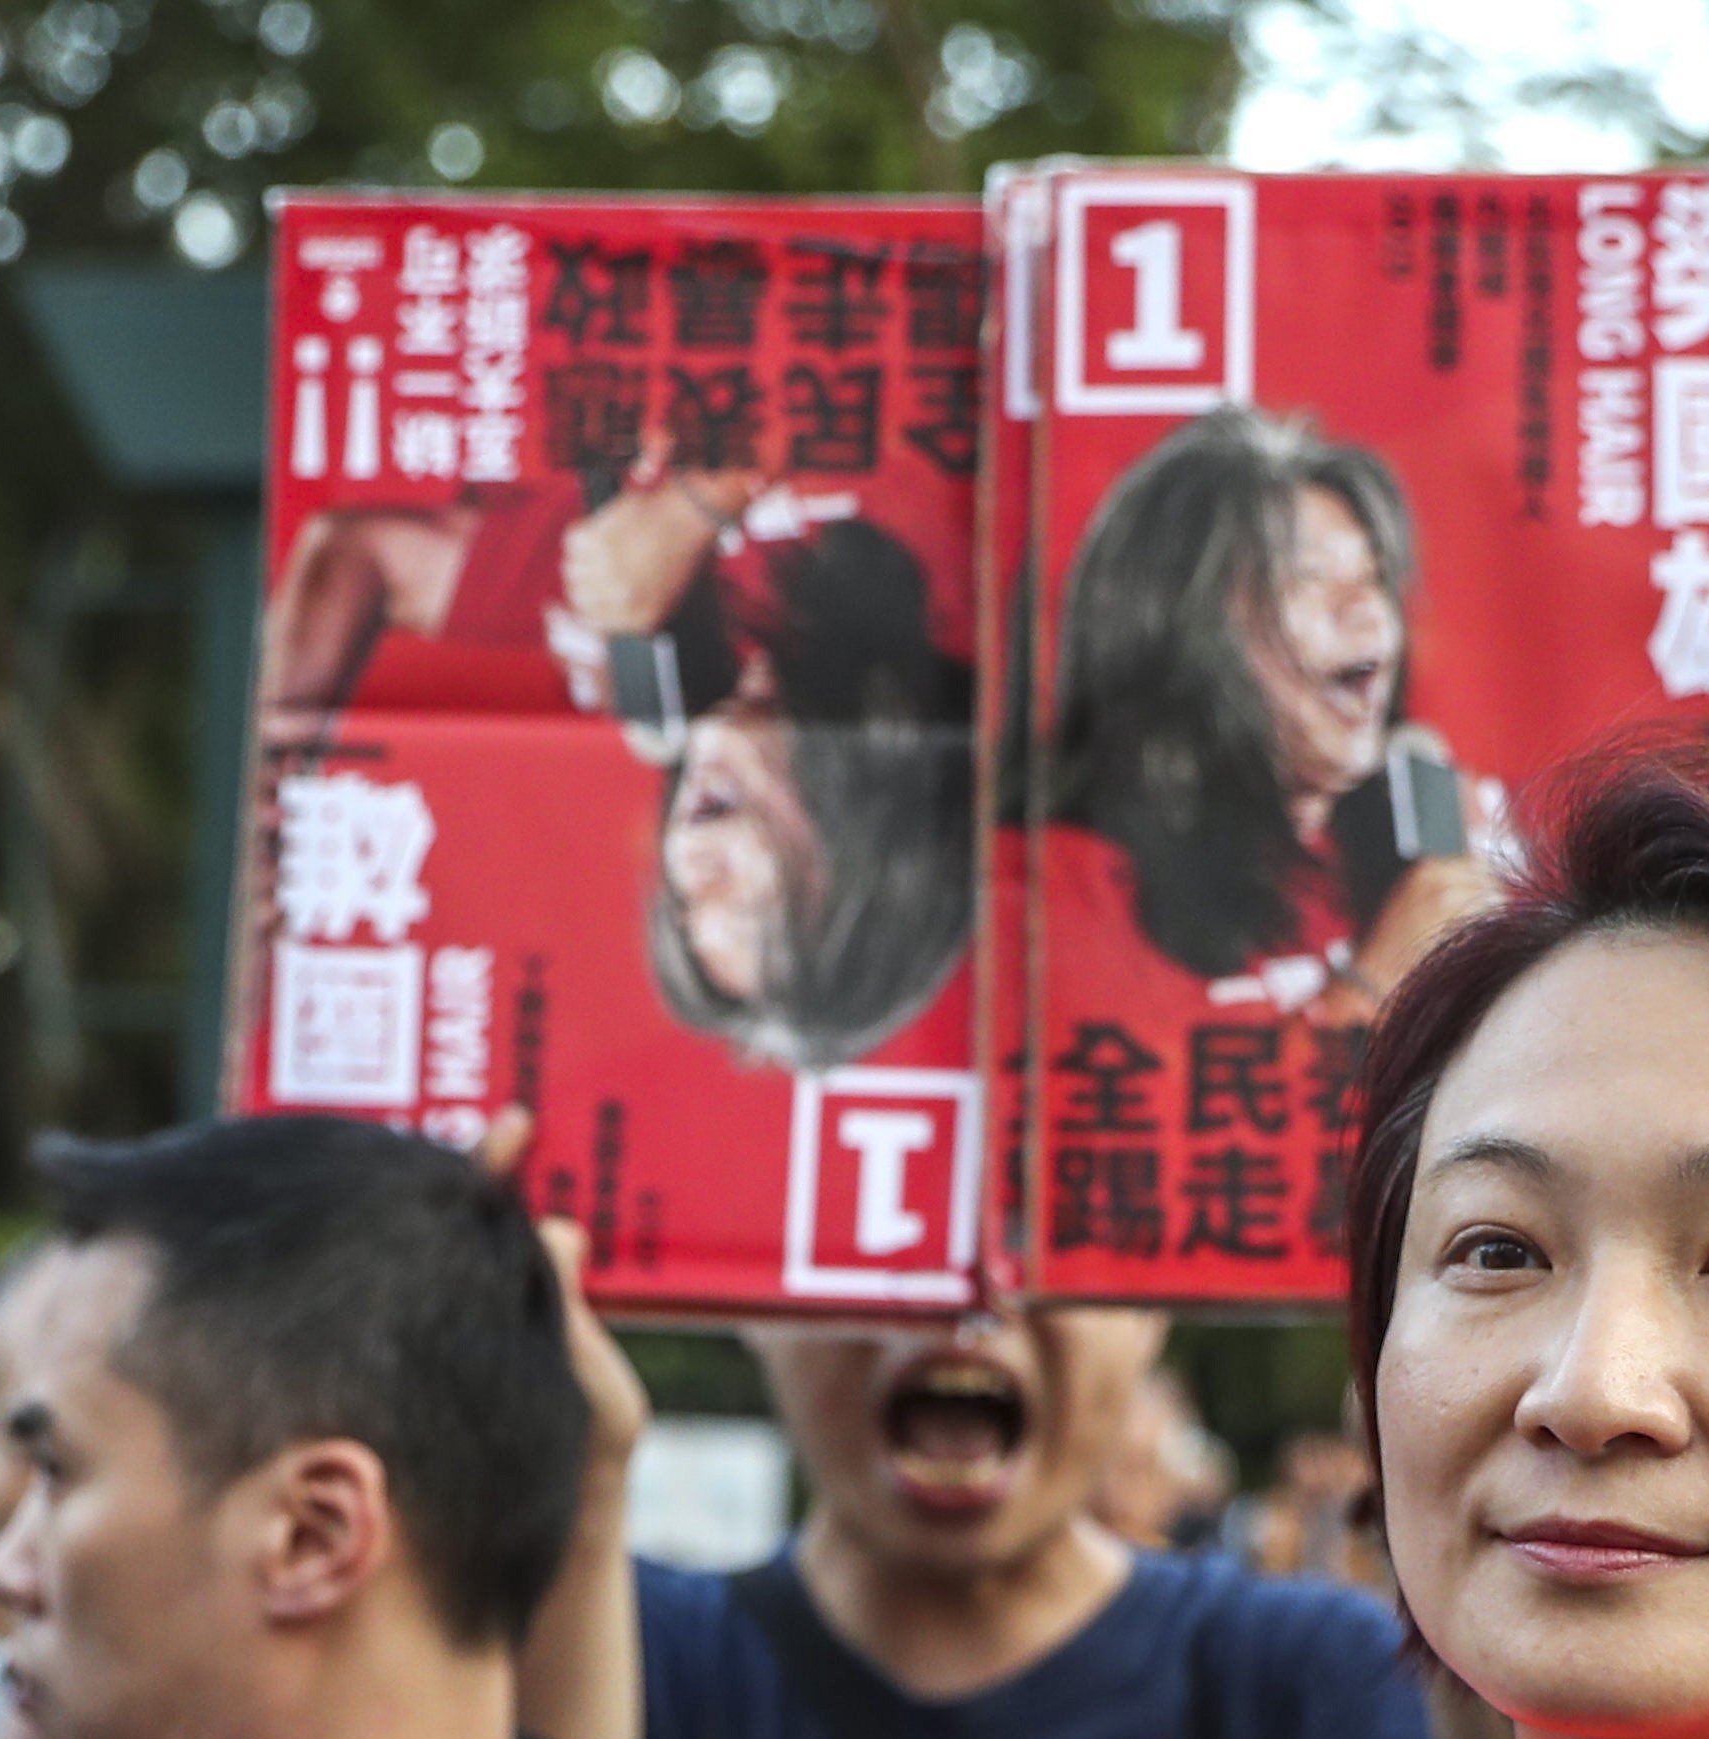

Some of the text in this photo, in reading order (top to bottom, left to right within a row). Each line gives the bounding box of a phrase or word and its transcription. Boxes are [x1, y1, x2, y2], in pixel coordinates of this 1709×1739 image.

[1104, 220, 1206, 372] 1
[1578, 183, 1645, 528] LONG HAIR
[838, 1110, 938, 1257] 1
